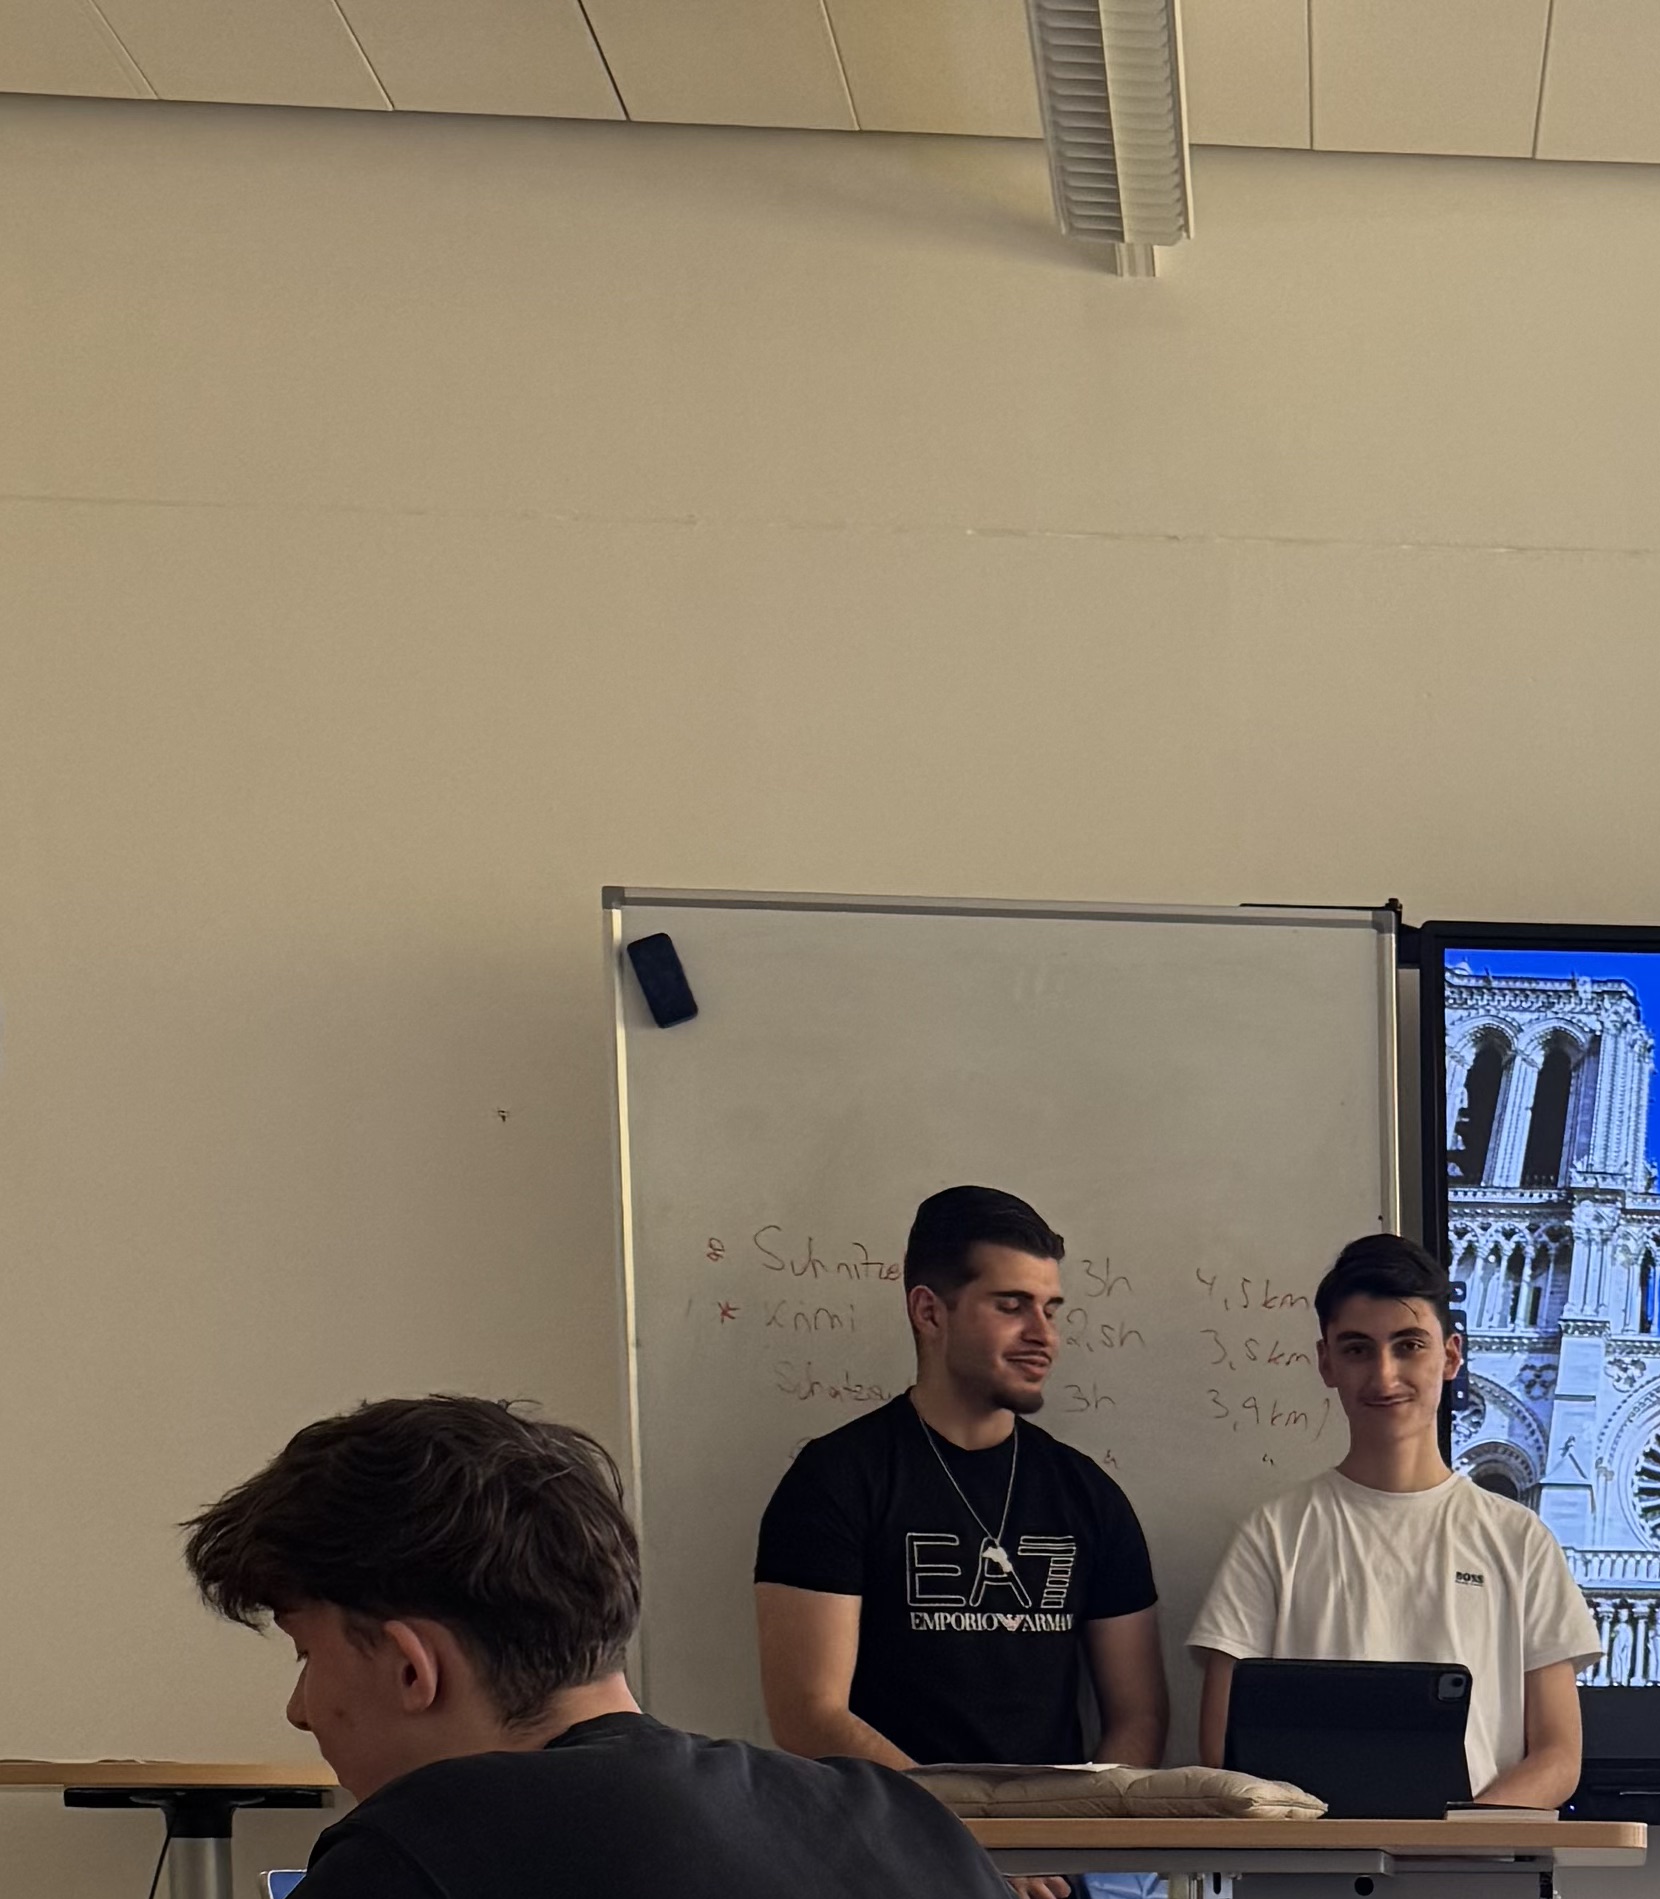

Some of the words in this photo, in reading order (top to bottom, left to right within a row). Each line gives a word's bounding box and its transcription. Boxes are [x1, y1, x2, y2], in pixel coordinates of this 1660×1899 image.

[754, 1225, 901, 1280] Schnitze
[1081, 1257, 1131, 1297] 3h
[905, 1532, 1077, 1609] EA7
[1455, 1571, 1484, 1584] BOSS
[910, 1611, 1000, 1631] EMPORIO
